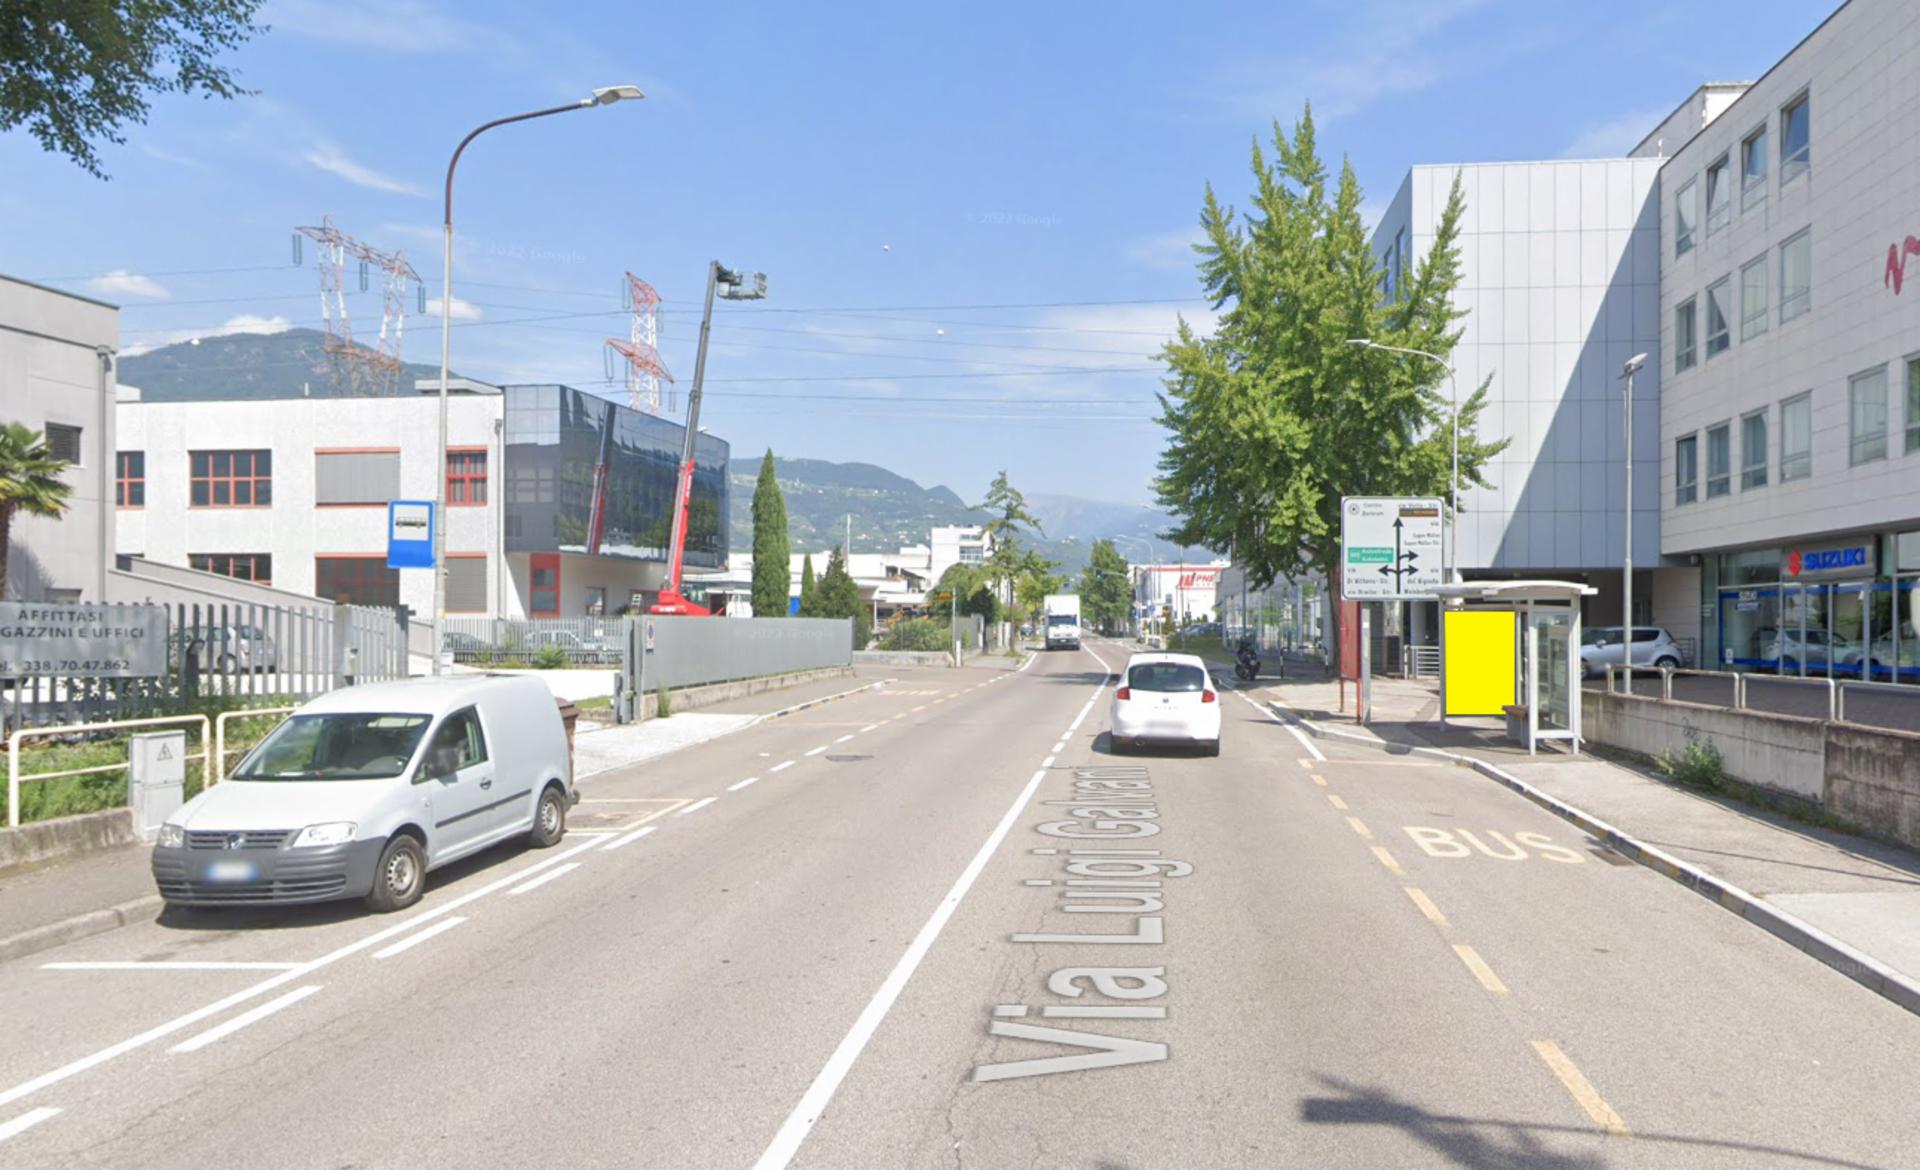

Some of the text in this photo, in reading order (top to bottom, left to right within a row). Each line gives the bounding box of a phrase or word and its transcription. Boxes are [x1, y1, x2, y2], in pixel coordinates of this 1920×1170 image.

[1804, 547, 1865, 570] SUZUKI
[18, 610, 104, 622] AFFITTASI
[78, 629, 88, 638] E
[93, 628, 144, 639] UFFICI
[1402, 826, 1586, 864] BUS
